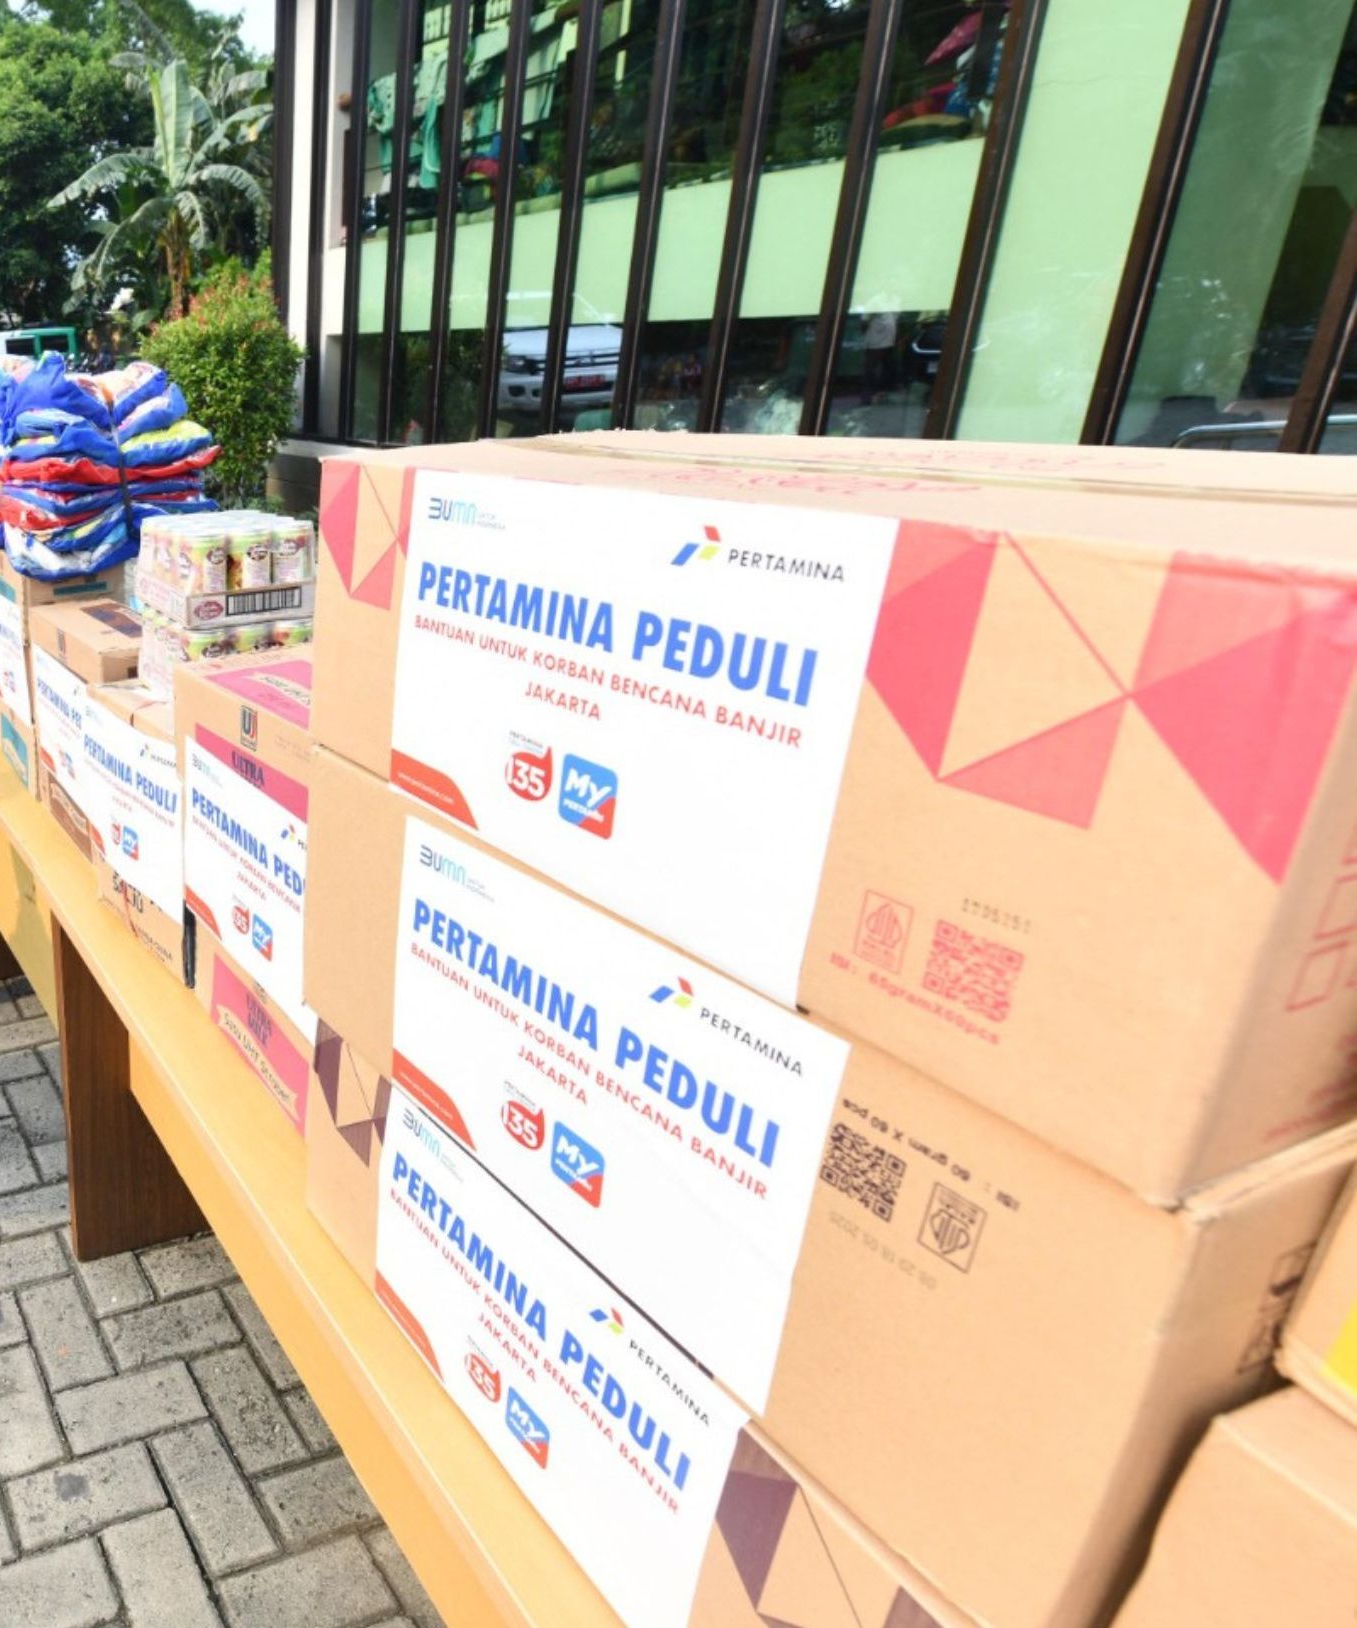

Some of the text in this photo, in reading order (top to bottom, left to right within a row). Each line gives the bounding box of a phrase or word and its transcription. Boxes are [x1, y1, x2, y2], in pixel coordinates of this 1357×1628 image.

[728, 548, 845, 582] PERTAMINA
[418, 561, 818, 707] PERTAMINA PEDULI
[414, 614, 803, 748] BANTUAN UNTUK KORBAN BENCANA BANJIR
[524, 681, 601, 720] JAKARTA
[84, 734, 132, 786] PERTAMINA
[136, 771, 178, 814] PEDULI
[231, 750, 265, 787] ULTRA
[506, 756, 546, 797] 135
[564, 768, 612, 808] MY
[192, 787, 268, 869] PERTAMINA
[412, 898, 780, 1169] PERTAMINA PEDULI
[700, 1007, 804, 1077] PERTAMINA
[411, 942, 469, 991] BANTUAN
[473, 984, 520, 1028] UNTUK
[523, 1020, 591, 1076] KORBAN
[595, 1070, 684, 1142] BENCANA
[689, 1136, 768, 1200] BANJIR
[517, 1045, 588, 1105] JAKARTA
[843, 1098, 869, 1119] pcs
[556, 1135, 600, 1177] MY
[390, 1187, 439, 1249] BANTUAN
[441, 1245, 481, 1295] UNTUK
[484, 1293, 540, 1359] KORBAN
[542, 1358, 614, 1443] BENCANA
[618, 1442, 678, 1514] BANJIR
[392, 1150, 691, 1492] PERTAMINA PEDULI
[478, 1312, 537, 1383] JAKARTA
[629, 1338, 710, 1427] PERTAMINA
